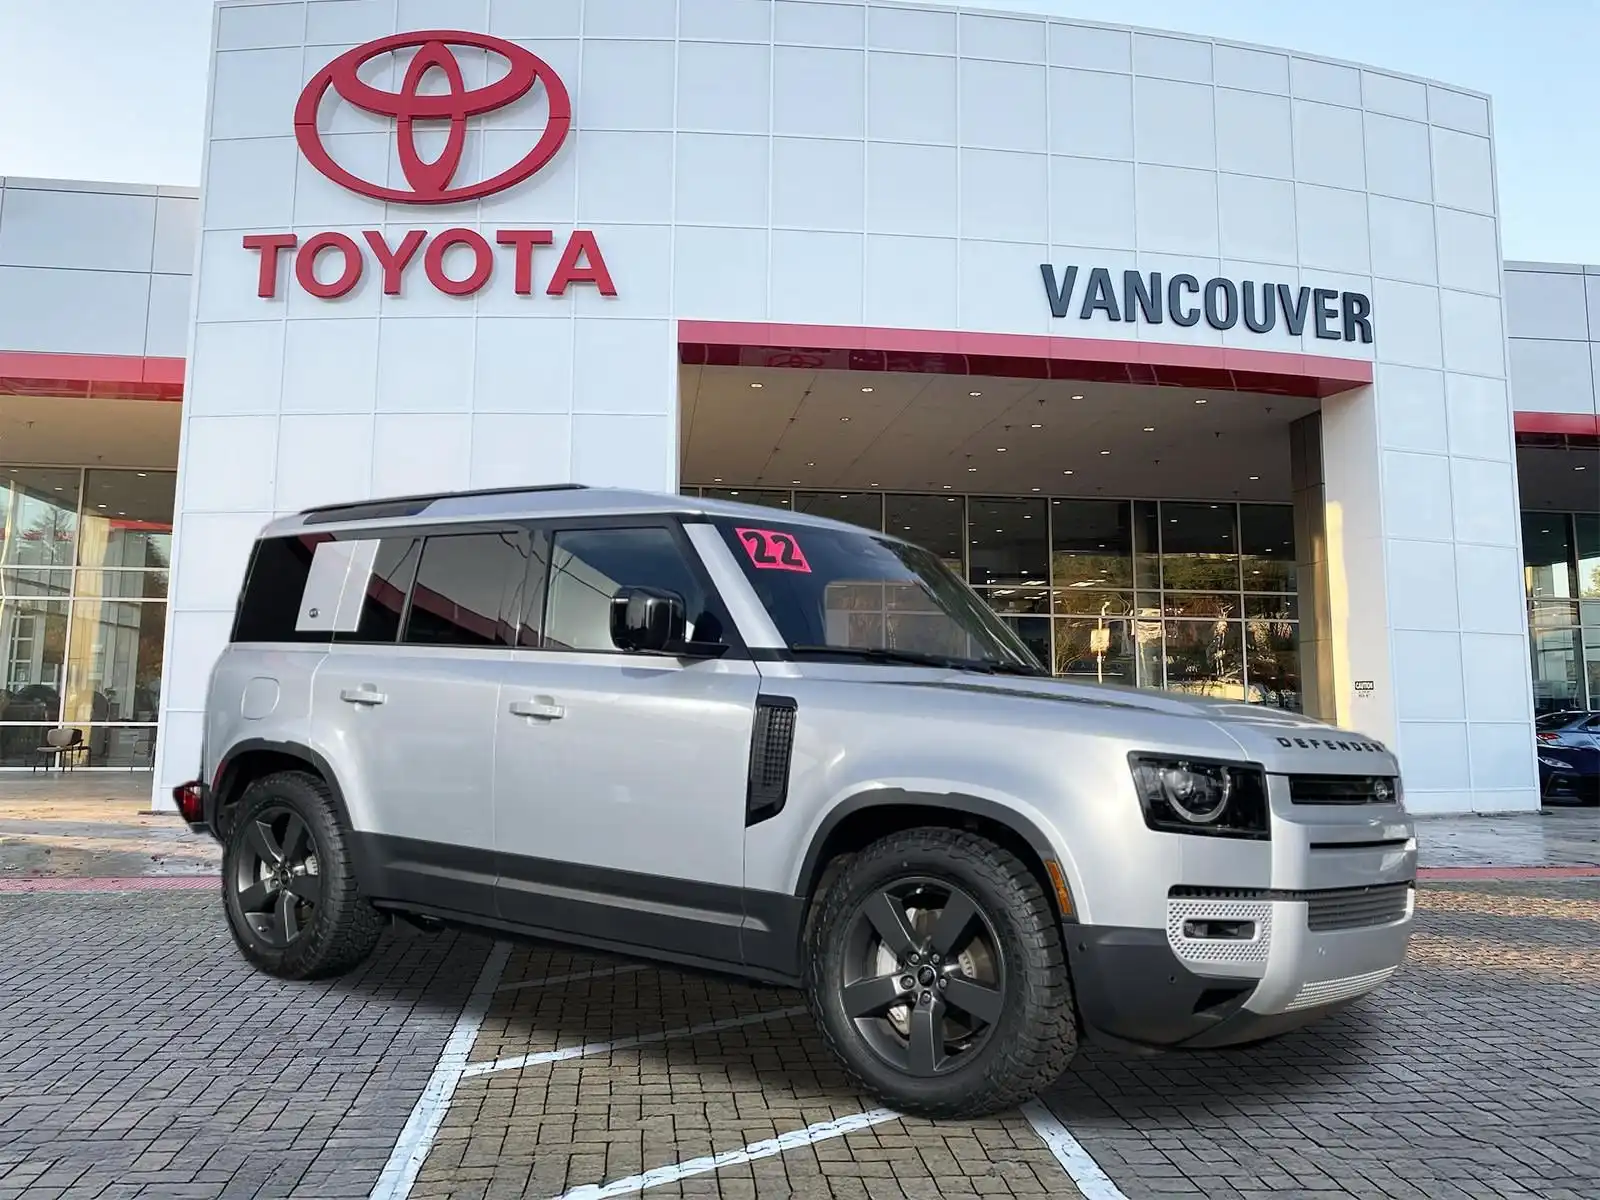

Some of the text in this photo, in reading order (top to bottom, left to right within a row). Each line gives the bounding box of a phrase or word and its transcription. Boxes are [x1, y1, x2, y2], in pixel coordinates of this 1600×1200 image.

[243, 228, 618, 298] TOYOTA
[1040, 264, 1373, 343] VANCOUVER
[742, 531, 803, 567] 22
[1276, 737, 1385, 752] DEFENDER
